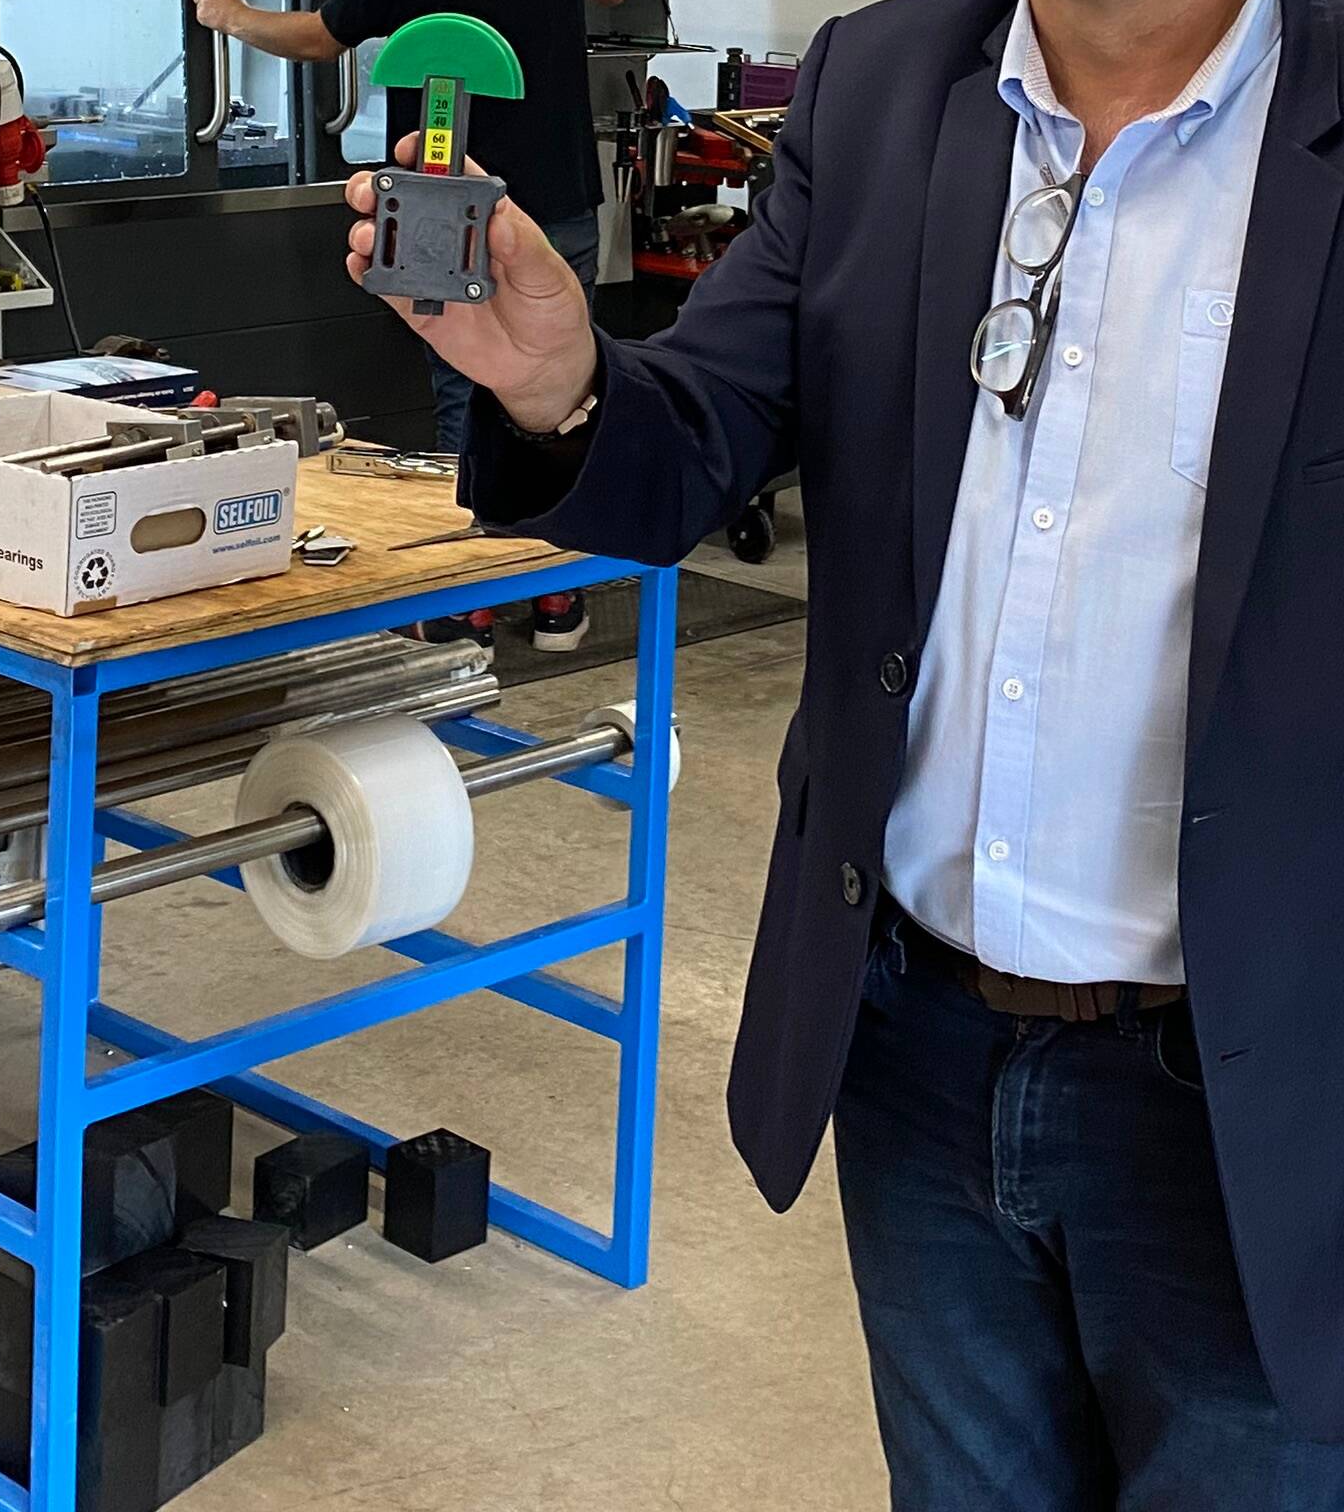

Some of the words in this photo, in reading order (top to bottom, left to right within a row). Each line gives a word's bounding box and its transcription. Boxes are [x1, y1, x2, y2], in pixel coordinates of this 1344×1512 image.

[435, 99, 449, 110] 20
[433, 116, 447, 127] 40
[432, 133, 446, 144] 60
[430, 150, 444, 161] 80
[218, 496, 277, 528] SELFOIL
